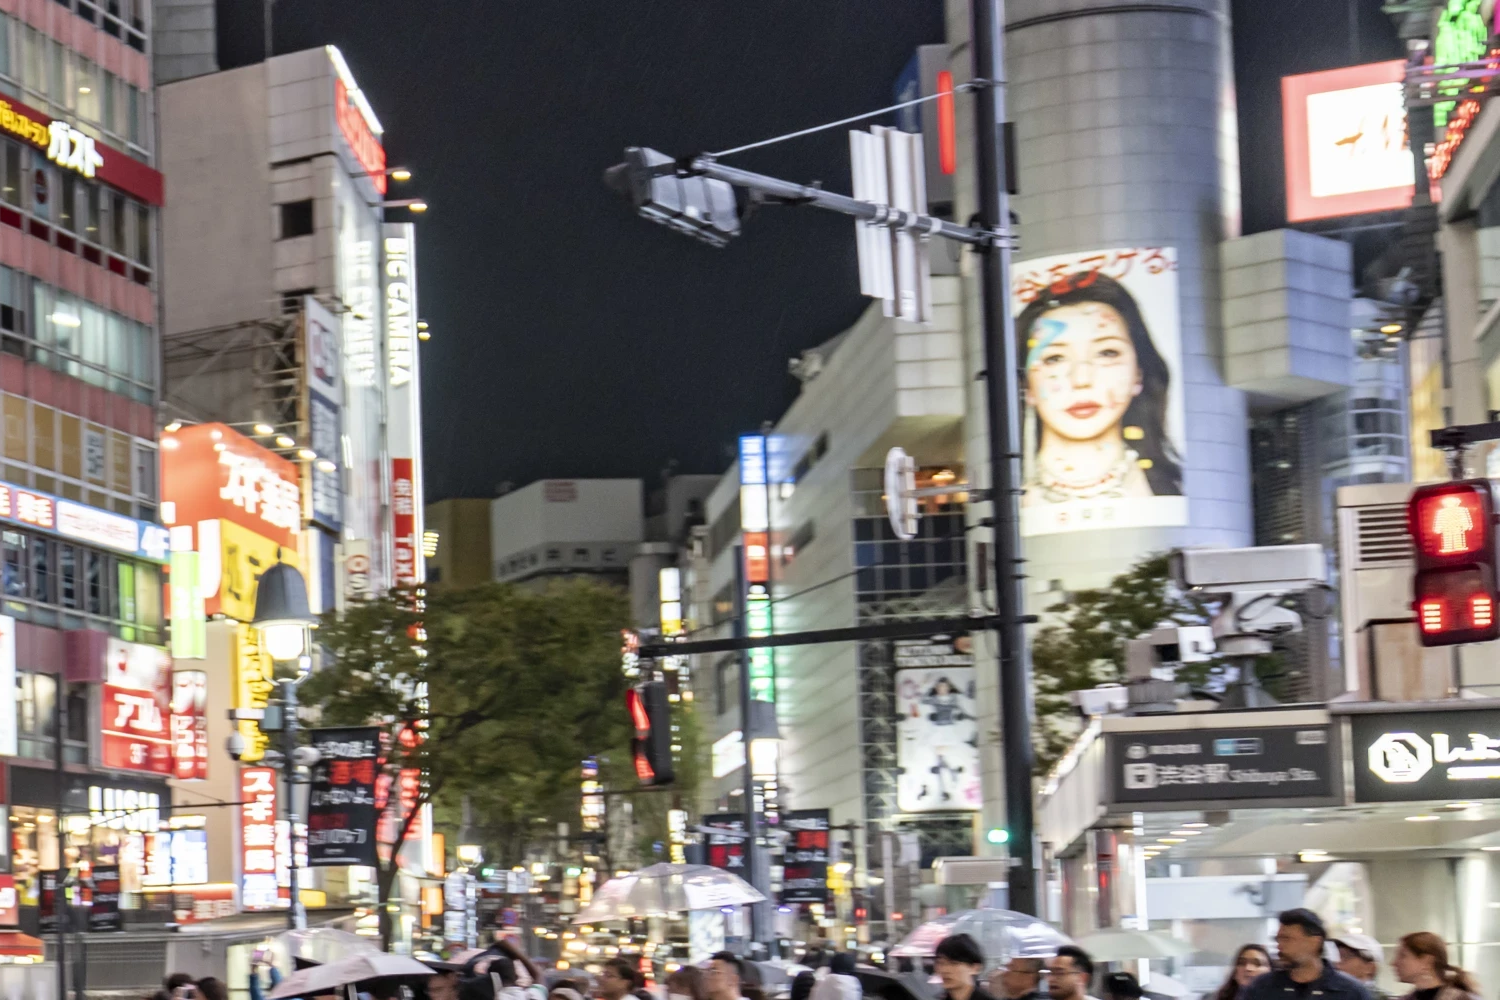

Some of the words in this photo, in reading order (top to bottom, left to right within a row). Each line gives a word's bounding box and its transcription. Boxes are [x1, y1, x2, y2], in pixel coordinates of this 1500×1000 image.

[47, 118, 104, 179] ガスト
[88, 785, 162, 833] LUSH
